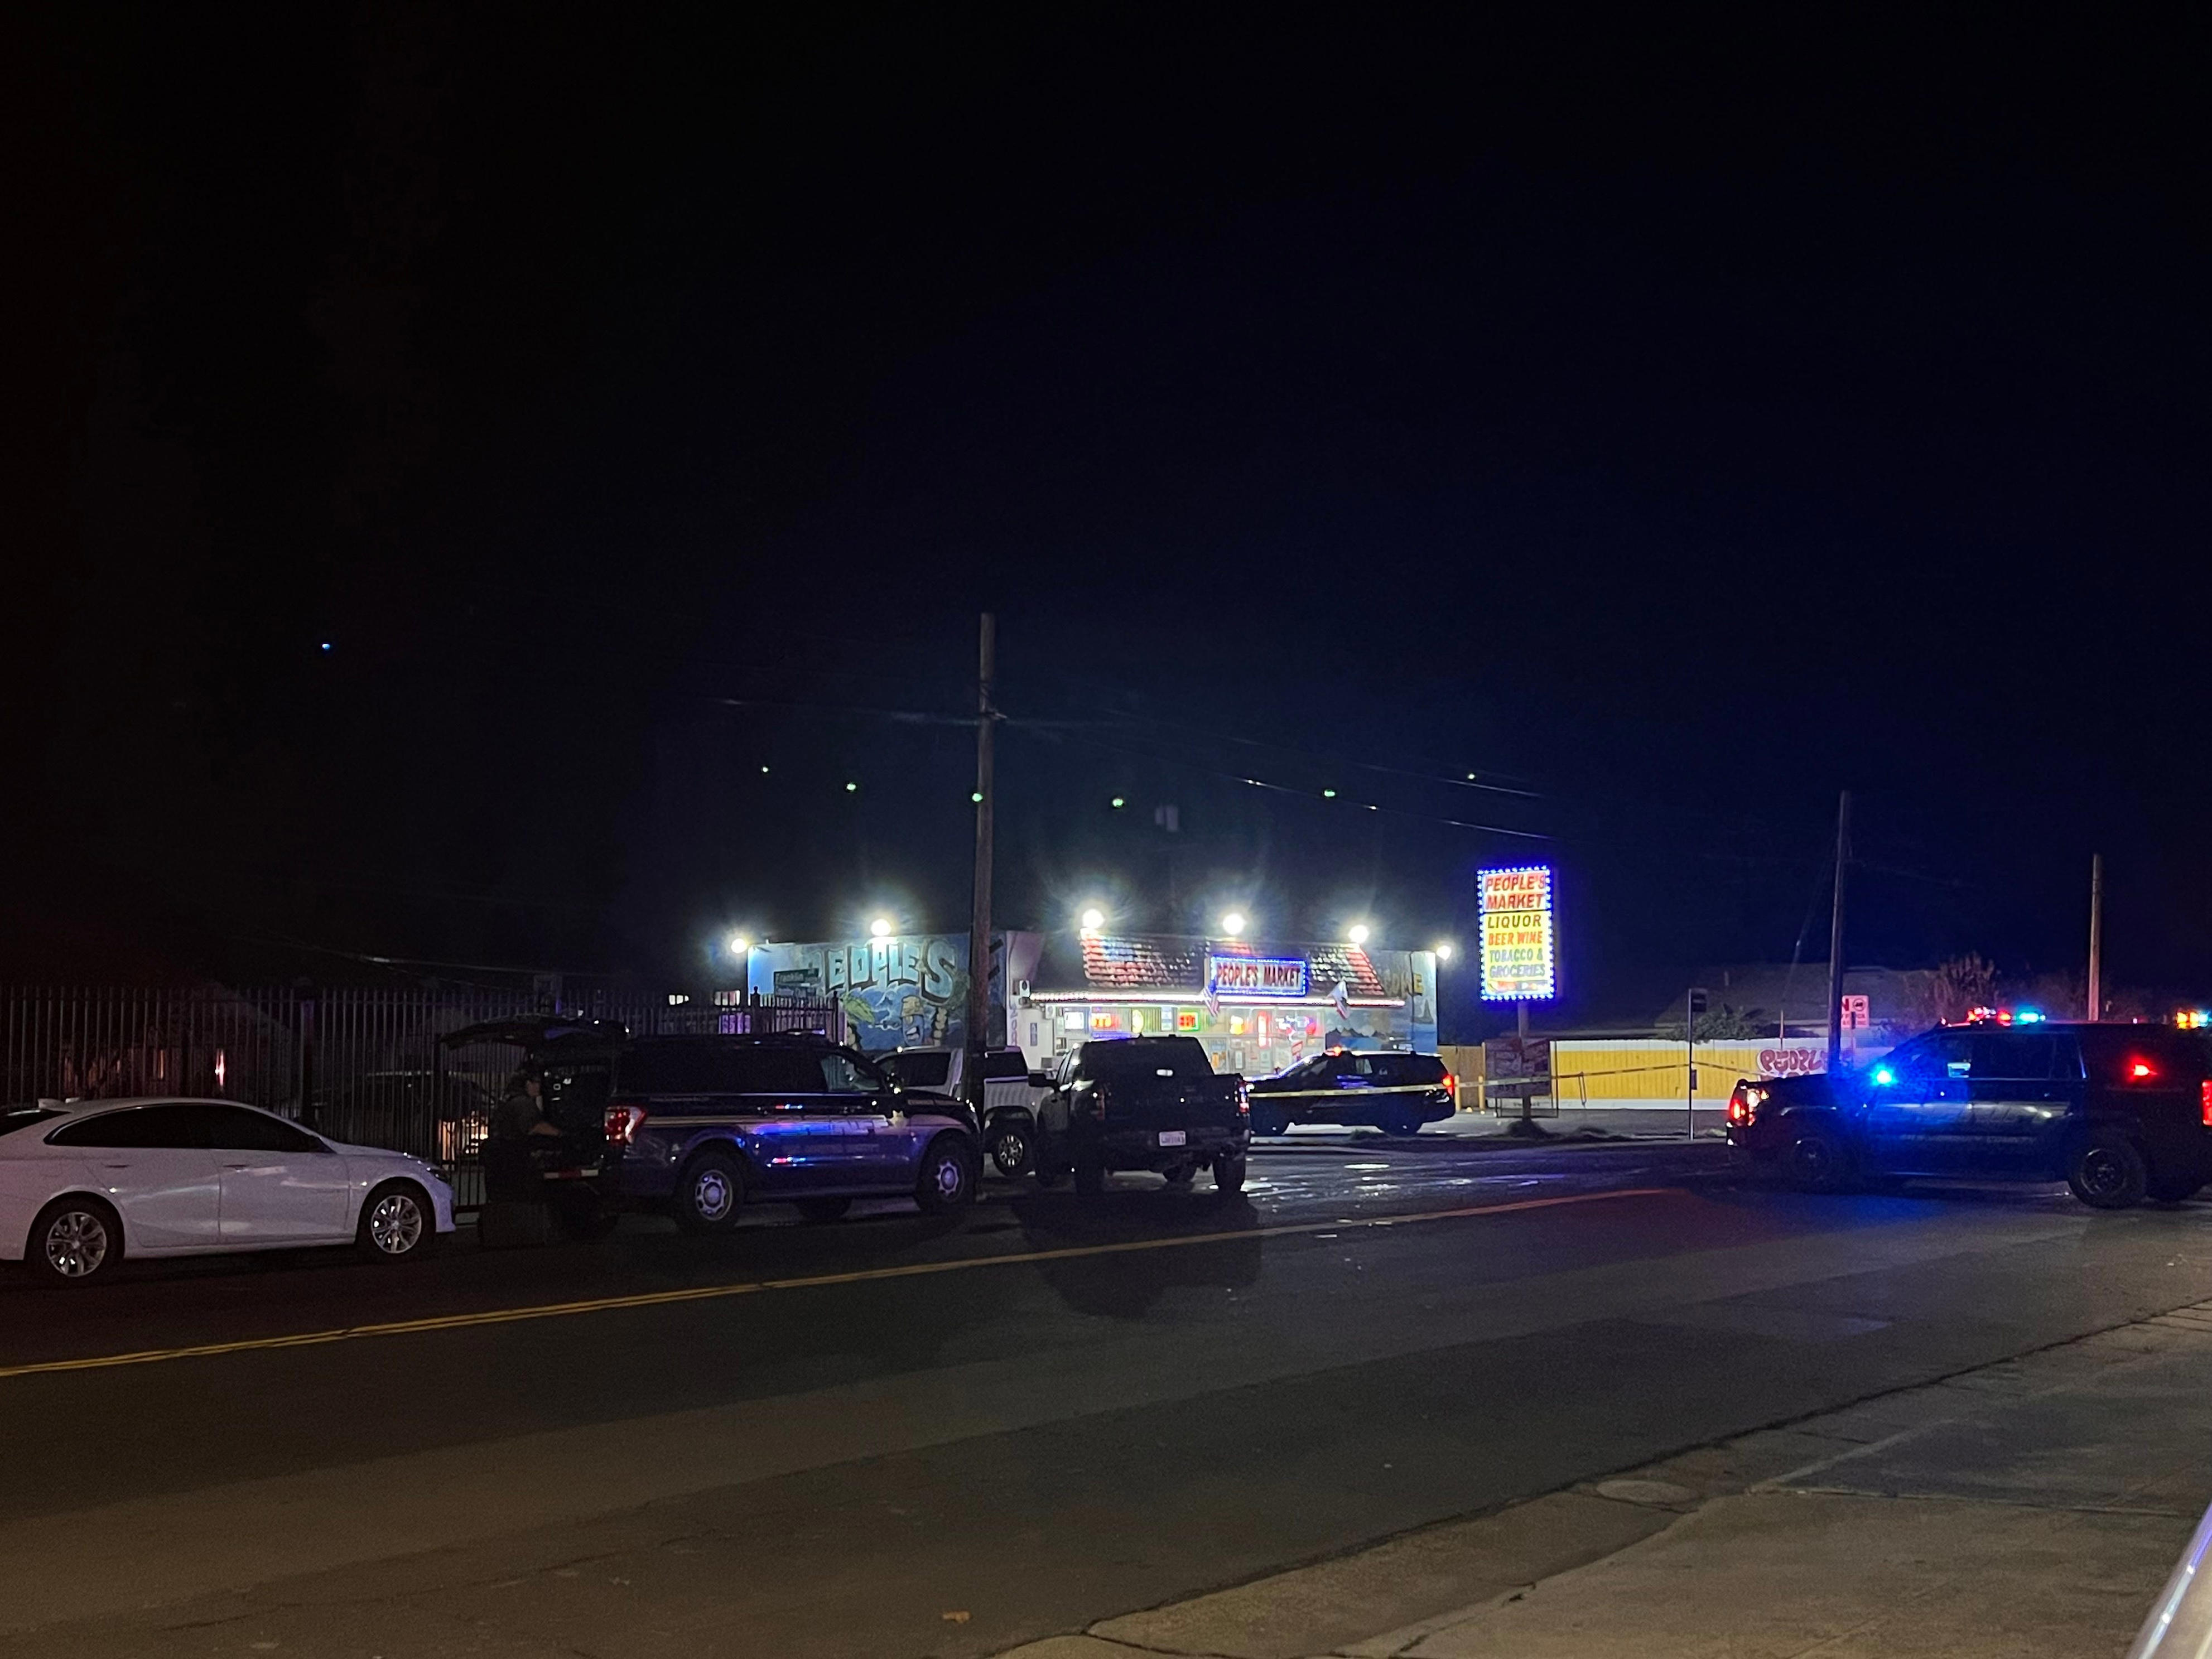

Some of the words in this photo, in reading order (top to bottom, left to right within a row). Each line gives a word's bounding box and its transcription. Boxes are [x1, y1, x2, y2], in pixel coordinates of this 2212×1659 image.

[1486, 874, 1545, 893] PEOPLE'S
[1486, 894, 1544, 909] MARKET
[1487, 914, 1541, 929] LIQUOR
[1488, 932, 1514, 946] BEER
[1517, 930, 1543, 944] WINE
[1490, 948, 1534, 963] TOBACCO
[1536, 948, 1544, 961] &
[1263, 964, 1301, 987] MARKET
[1489, 963, 1546, 978] GROCERIES
